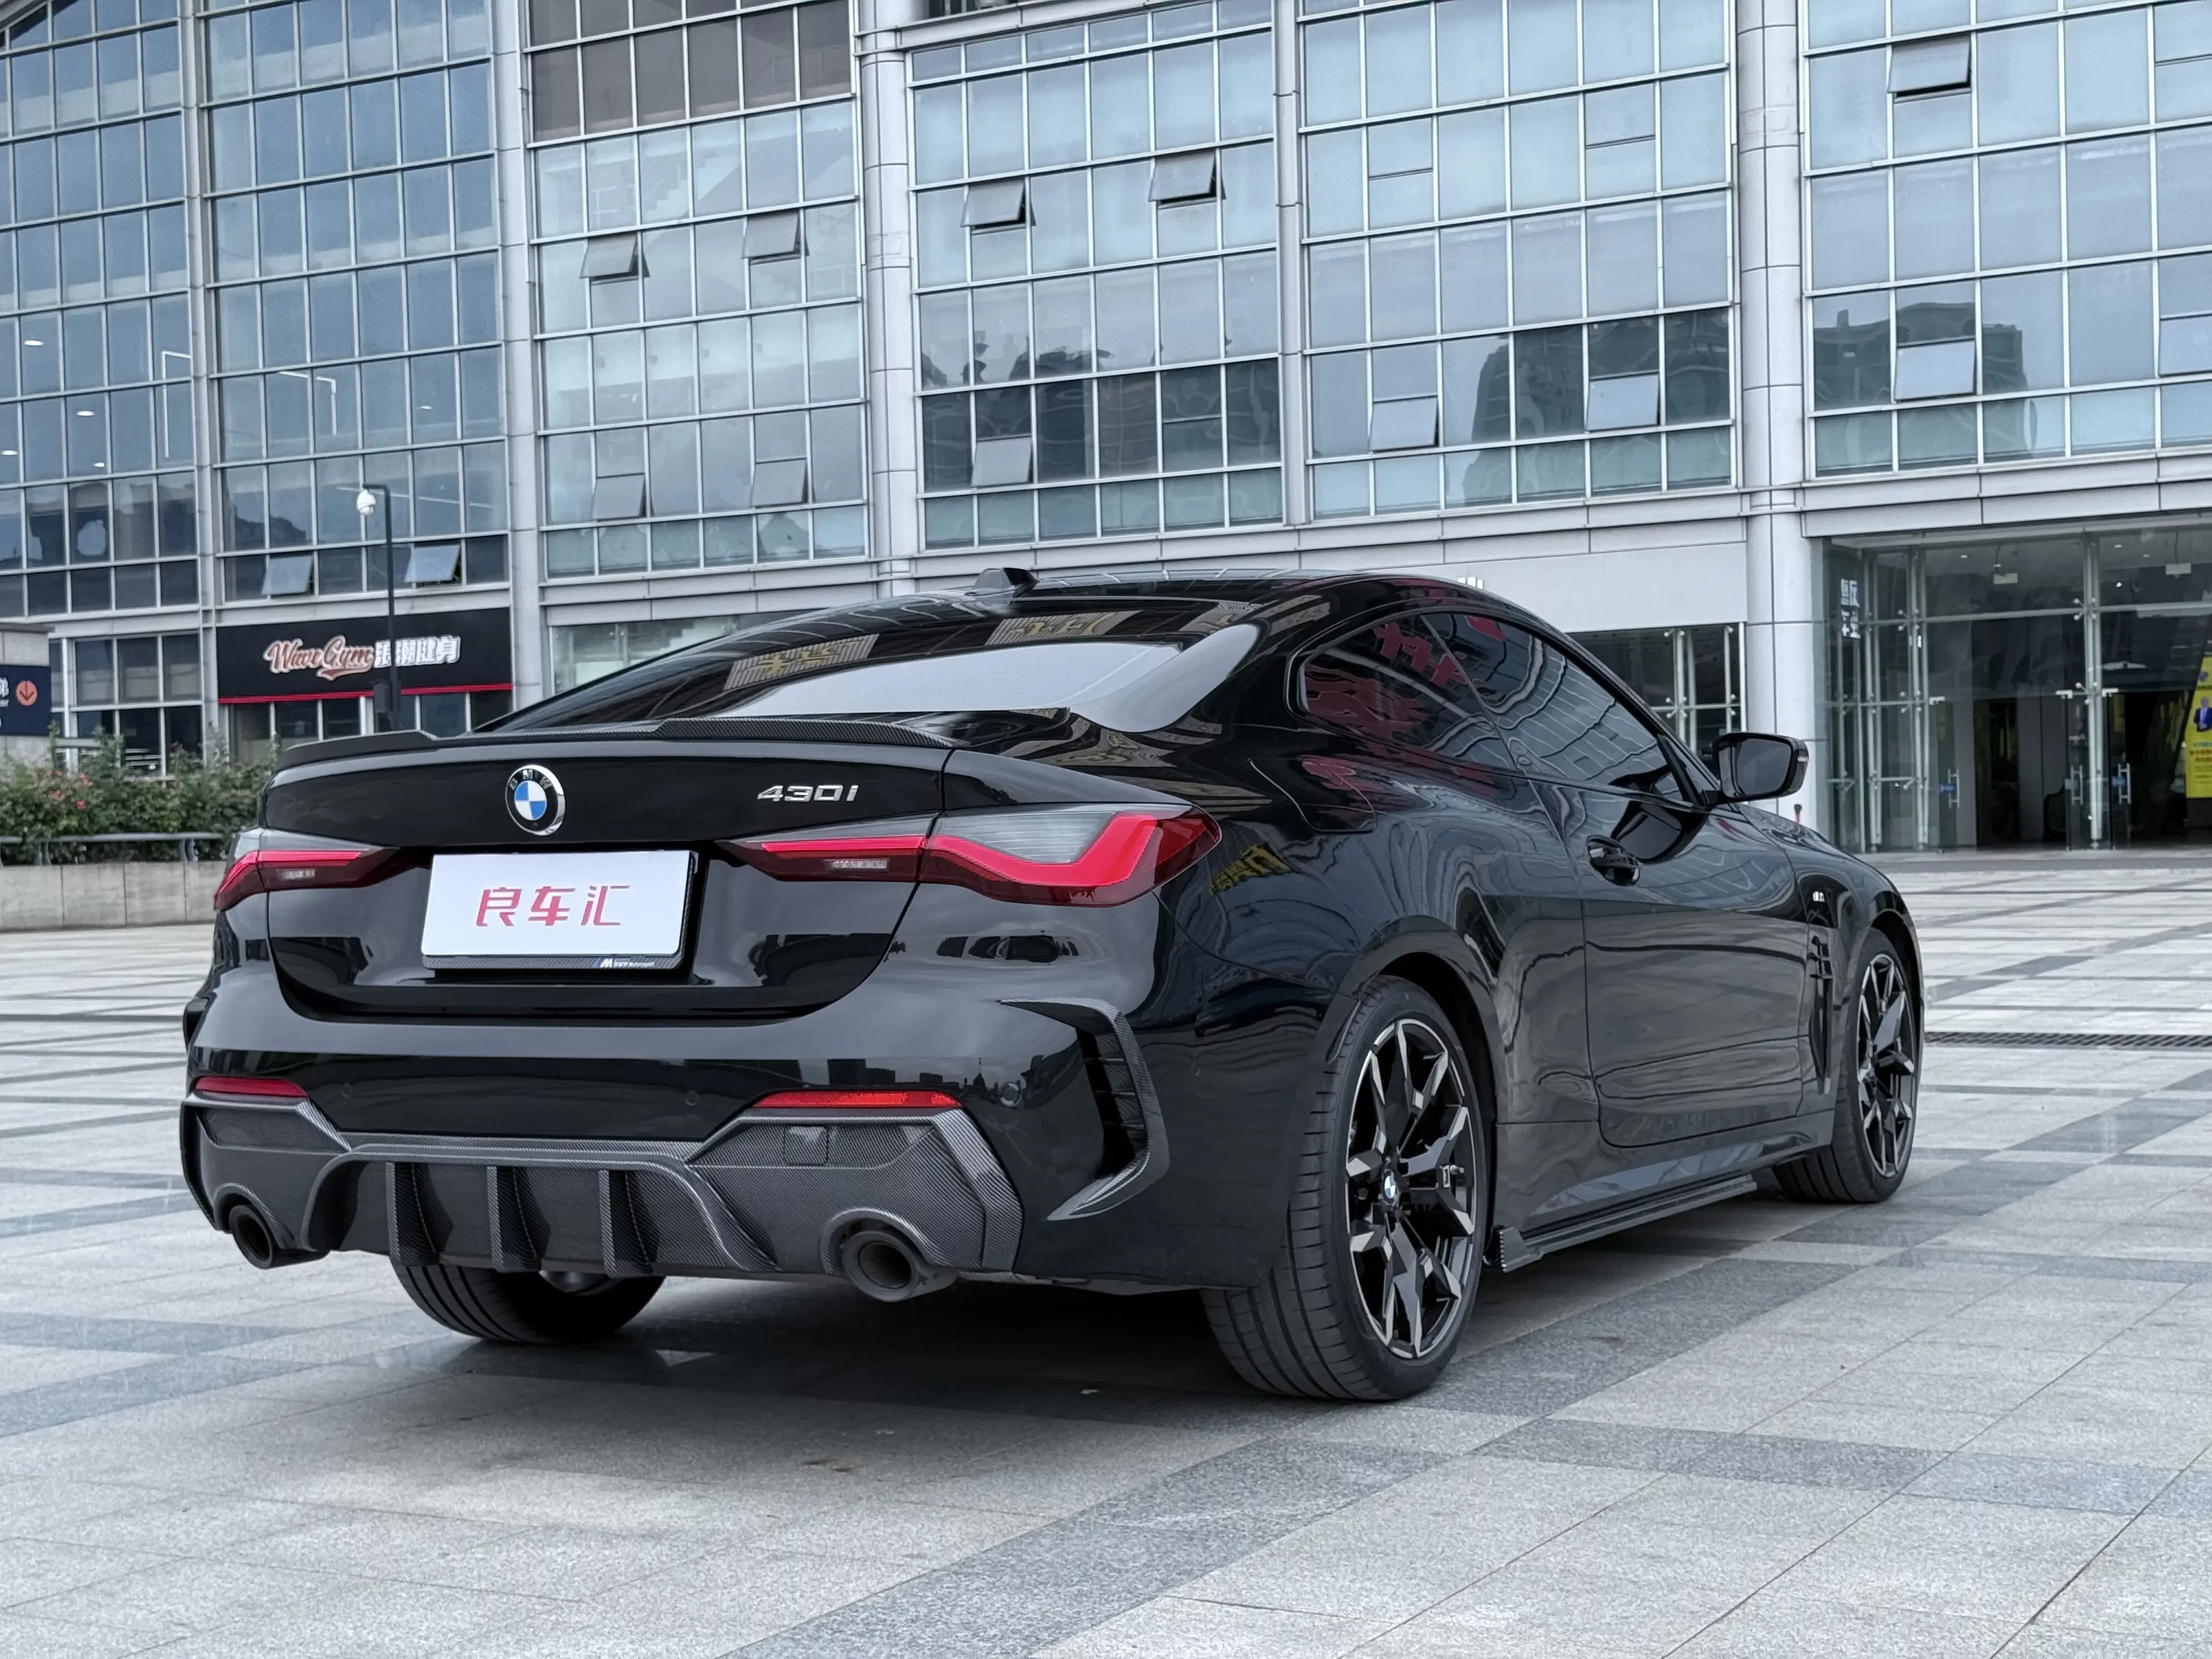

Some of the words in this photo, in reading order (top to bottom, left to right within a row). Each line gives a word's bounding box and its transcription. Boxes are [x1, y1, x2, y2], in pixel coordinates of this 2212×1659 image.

[509, 769, 553, 791] BMW
[757, 785, 859, 802] 430i
[476, 885, 630, 927] 良车汇
